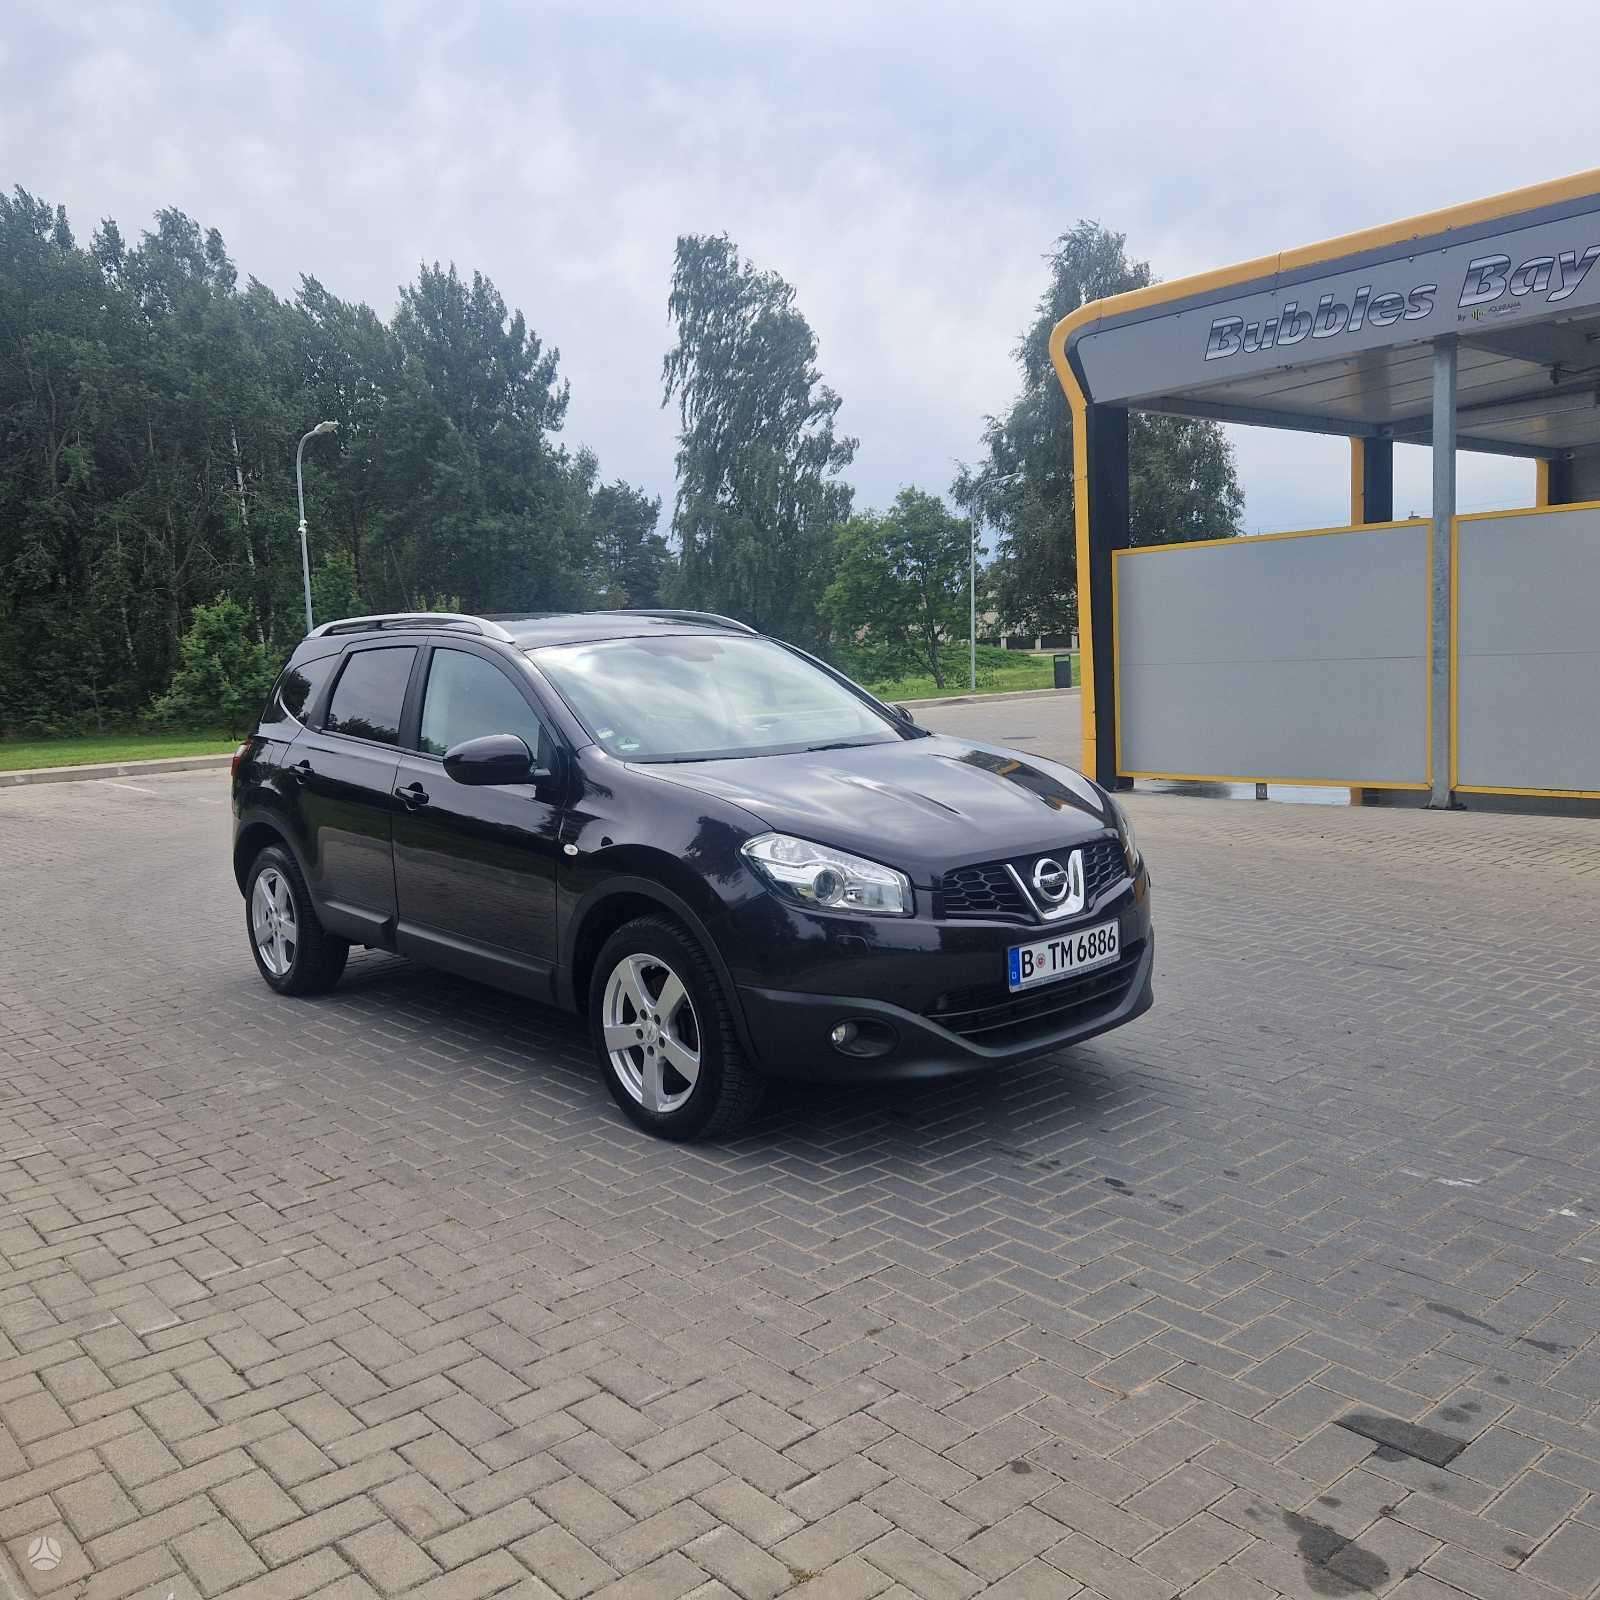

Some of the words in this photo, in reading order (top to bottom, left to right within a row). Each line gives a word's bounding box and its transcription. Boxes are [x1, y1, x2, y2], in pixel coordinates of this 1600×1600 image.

[1204, 285, 1438, 361] Bubbles
[1457, 245, 1600, 308] Bay
[1021, 949, 1035, 979] B
